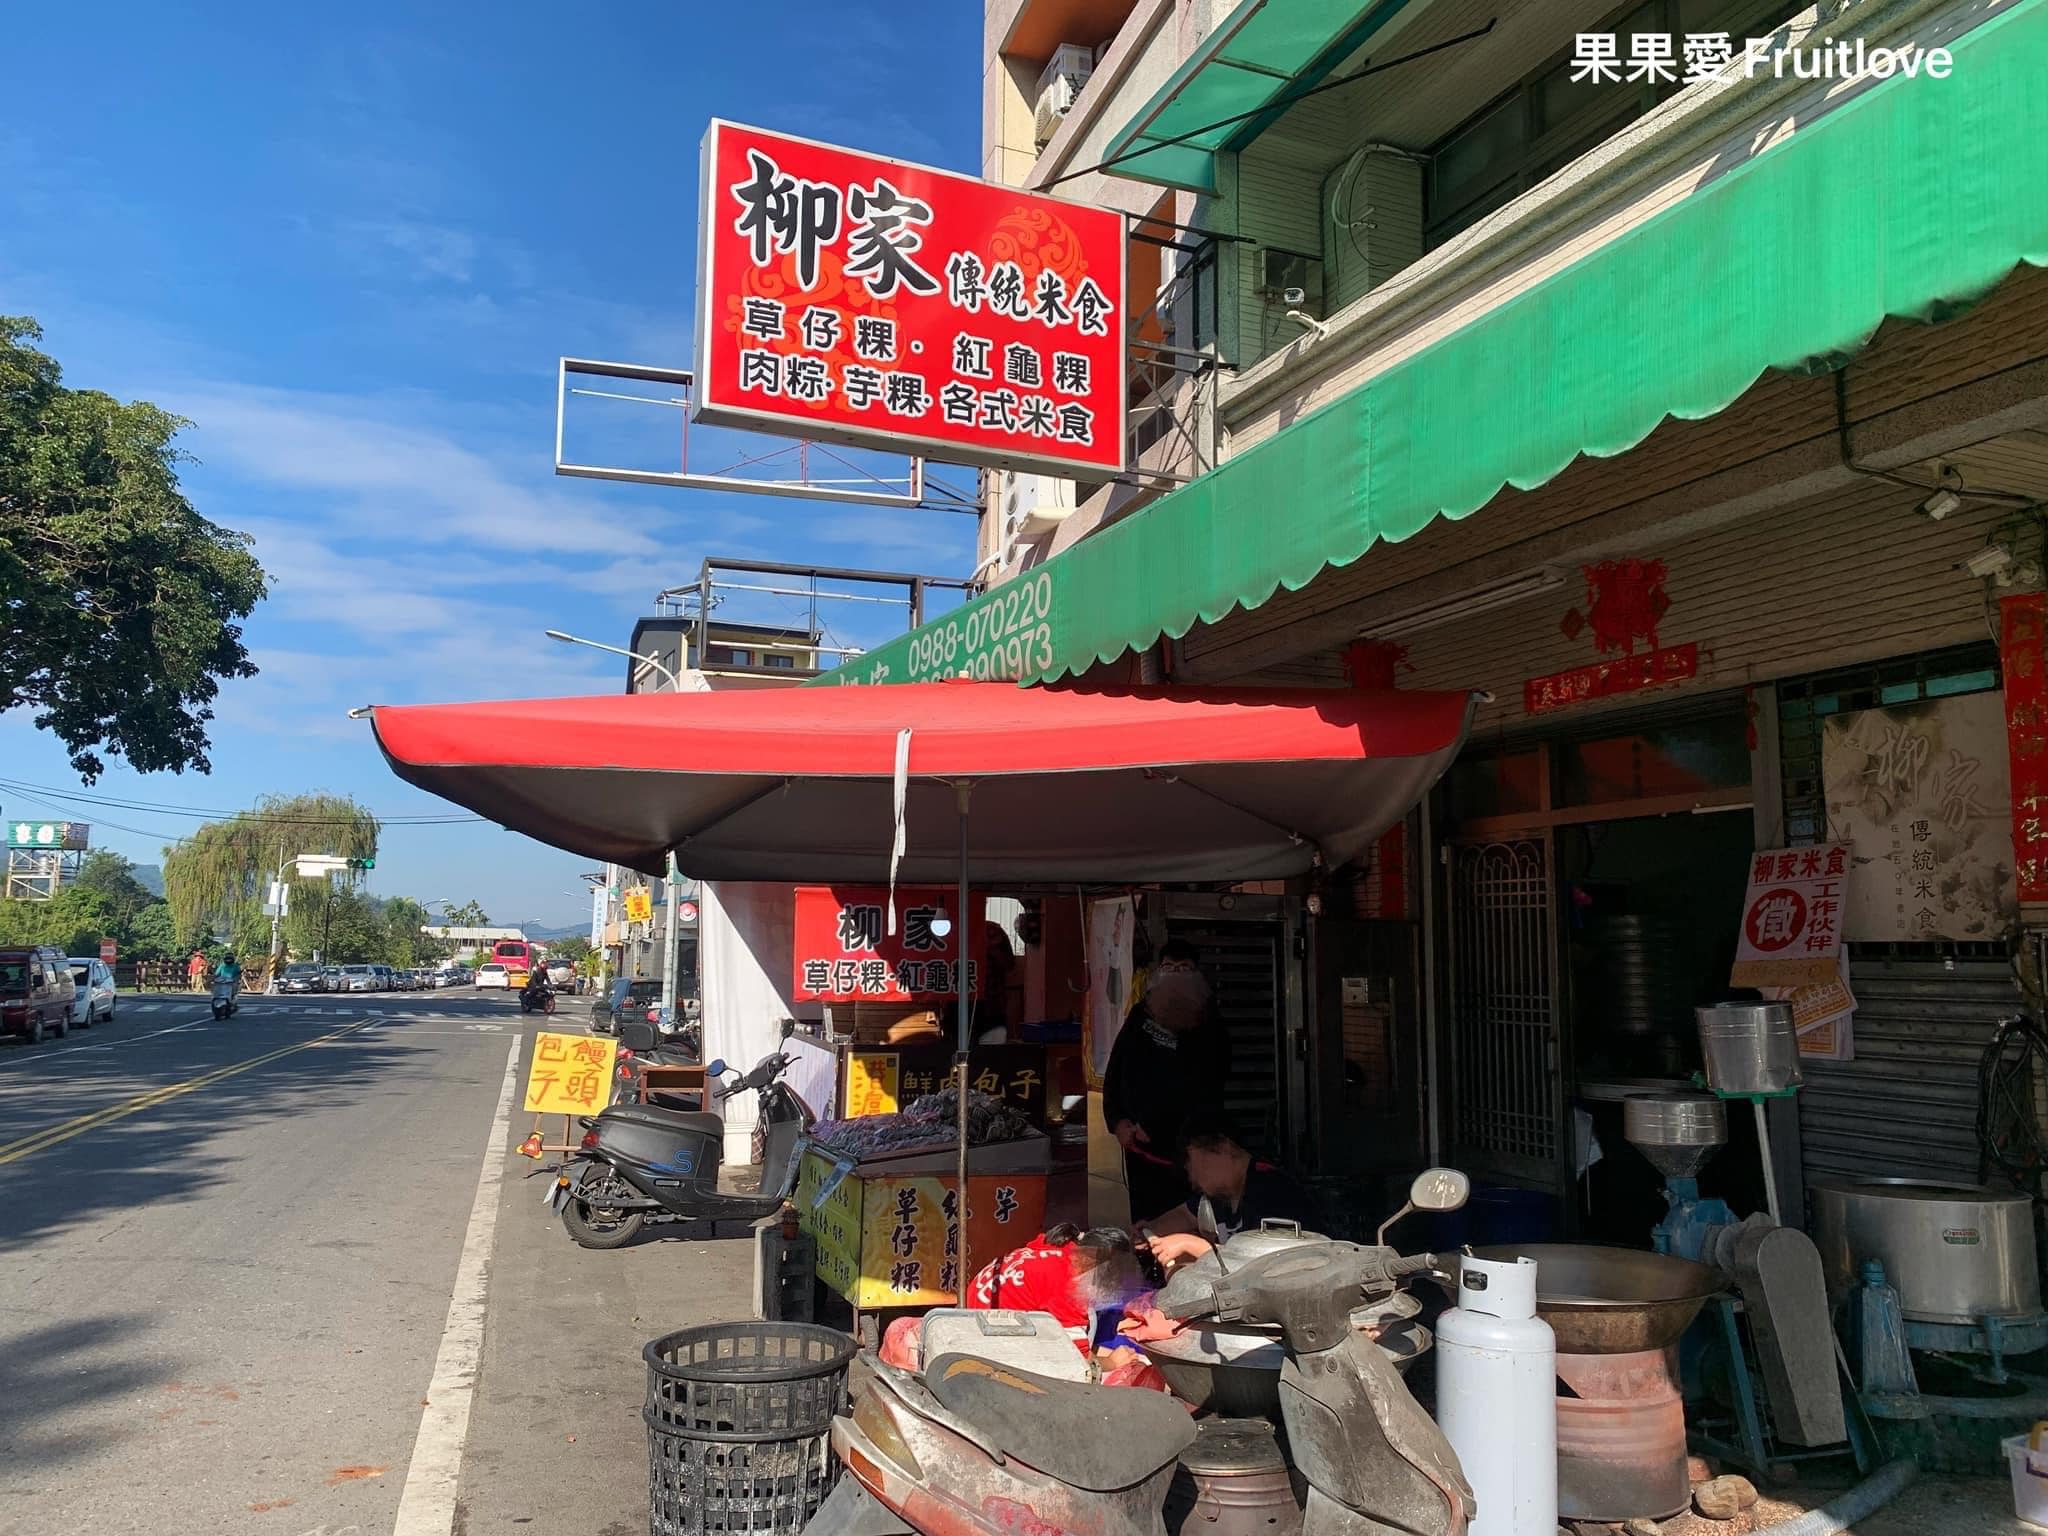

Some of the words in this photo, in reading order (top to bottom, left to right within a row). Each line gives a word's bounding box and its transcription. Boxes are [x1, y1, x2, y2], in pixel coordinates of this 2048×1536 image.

[732, 149, 941, 296] 柳家
[948, 253, 1112, 335] 傳統米食
[908, 572, 1052, 677] 0988-070220
[1754, 847, 1846, 884] 柳家米食
[1910, 820, 1937, 930] 傳統米食
[838, 904, 947, 950] 柳家
[1756, 896, 1797, 945] 徵
[1805, 882, 1841, 951] 工作伙伴
[528, 1034, 568, 1105] 包子
[558, 1039, 608, 1107] 饅頭
[890, 1188, 921, 1293] 草仔粿
